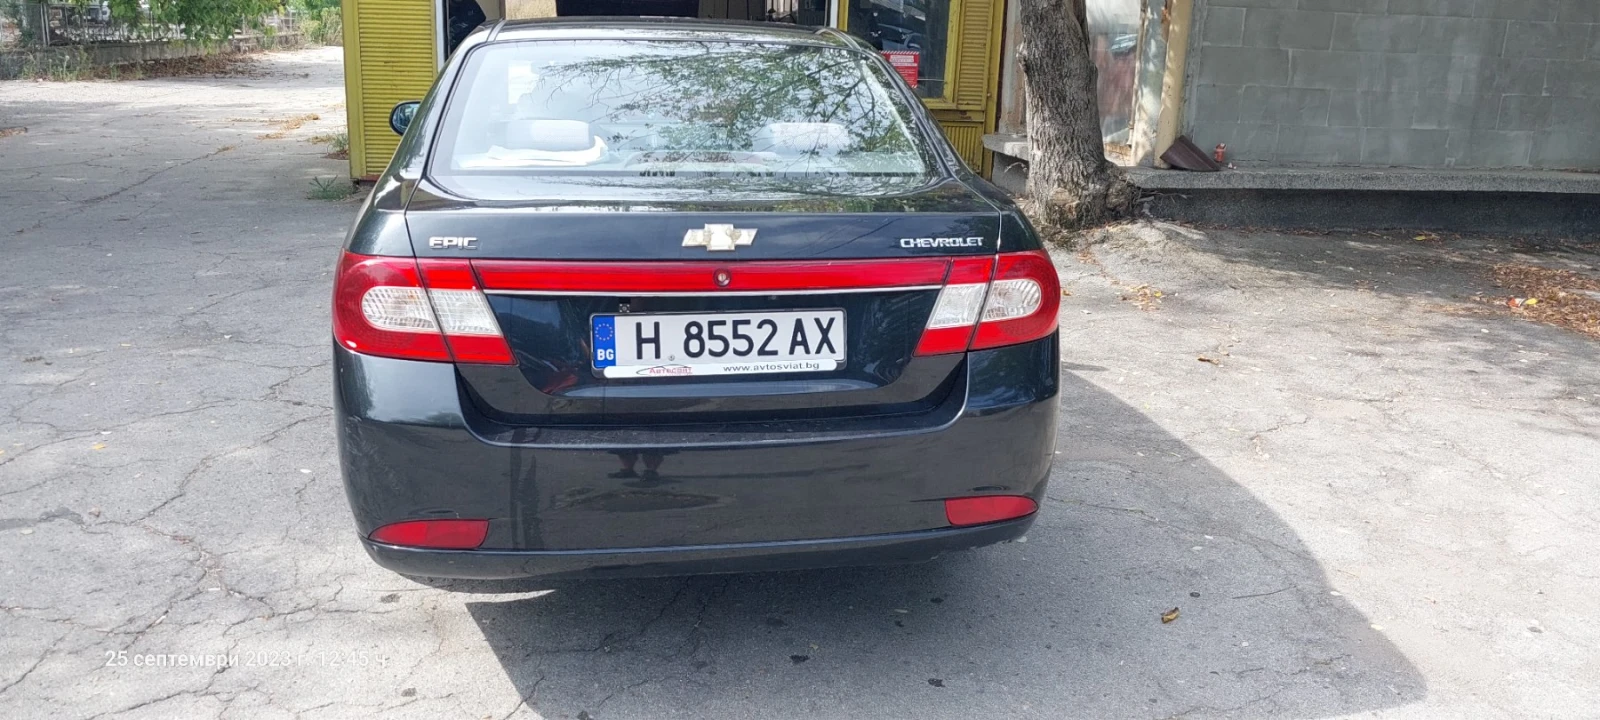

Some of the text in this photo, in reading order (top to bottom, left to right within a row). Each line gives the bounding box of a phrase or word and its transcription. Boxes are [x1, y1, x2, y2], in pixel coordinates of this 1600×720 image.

[429, 236, 477, 250] EPIC
[900, 237, 984, 248] CHEVROLET
[636, 317, 837, 360] H 8552 AX
[597, 349, 615, 361] BG
[723, 362, 820, 373] www.avtosviat.bg
